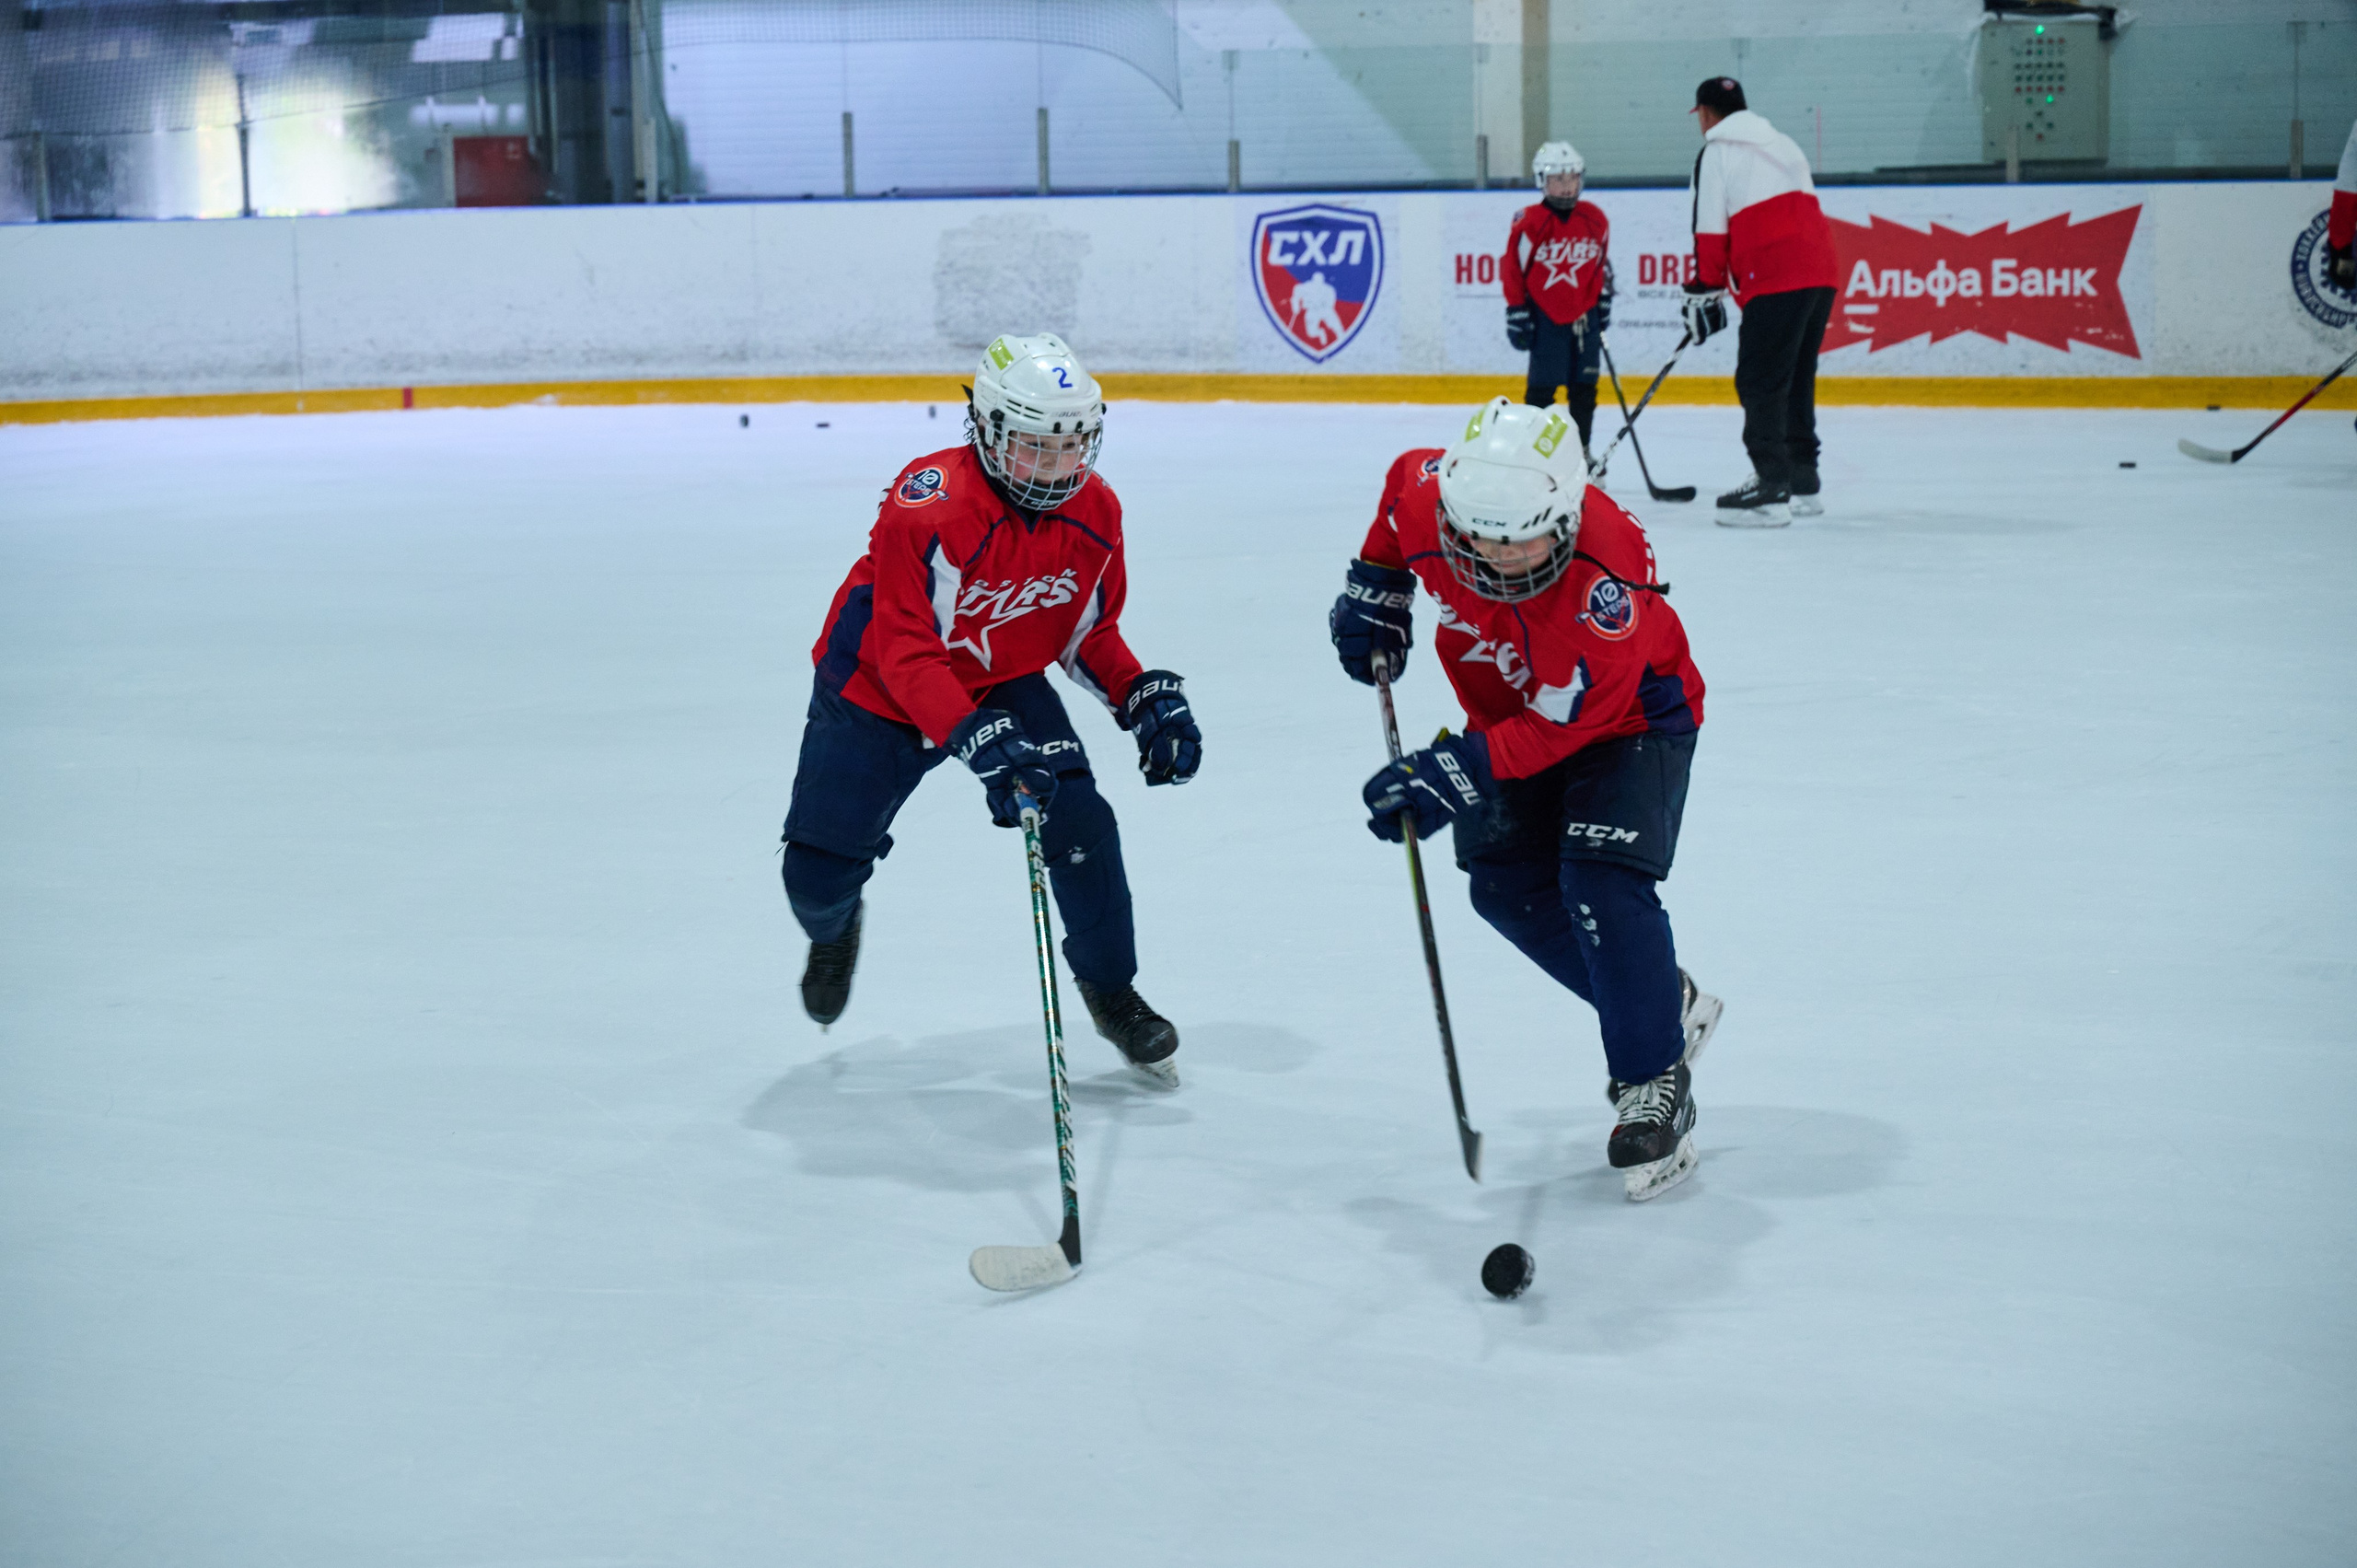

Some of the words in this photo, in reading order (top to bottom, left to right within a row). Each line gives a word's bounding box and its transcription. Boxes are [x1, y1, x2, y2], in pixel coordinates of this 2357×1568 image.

[1267, 230, 1366, 266] СХЛ
[1534, 241, 1599, 262] STARS
[1638, 253, 1697, 285] DRE
[1844, 259, 1982, 308] Альфа
[1991, 259, 2098, 297] Банк
[1051, 366, 1074, 389] 2
[917, 470, 939, 486] 10
[1472, 517, 1508, 528] CCM
[959, 568, 1078, 596] OSTON
[1345, 581, 1415, 609] AUER
[1593, 582, 1620, 609] 10
[958, 577, 1080, 621] TARS
[1036, 739, 1080, 756] CM
[1434, 751, 1480, 806] BAU
[1567, 822, 1640, 844] CCM
